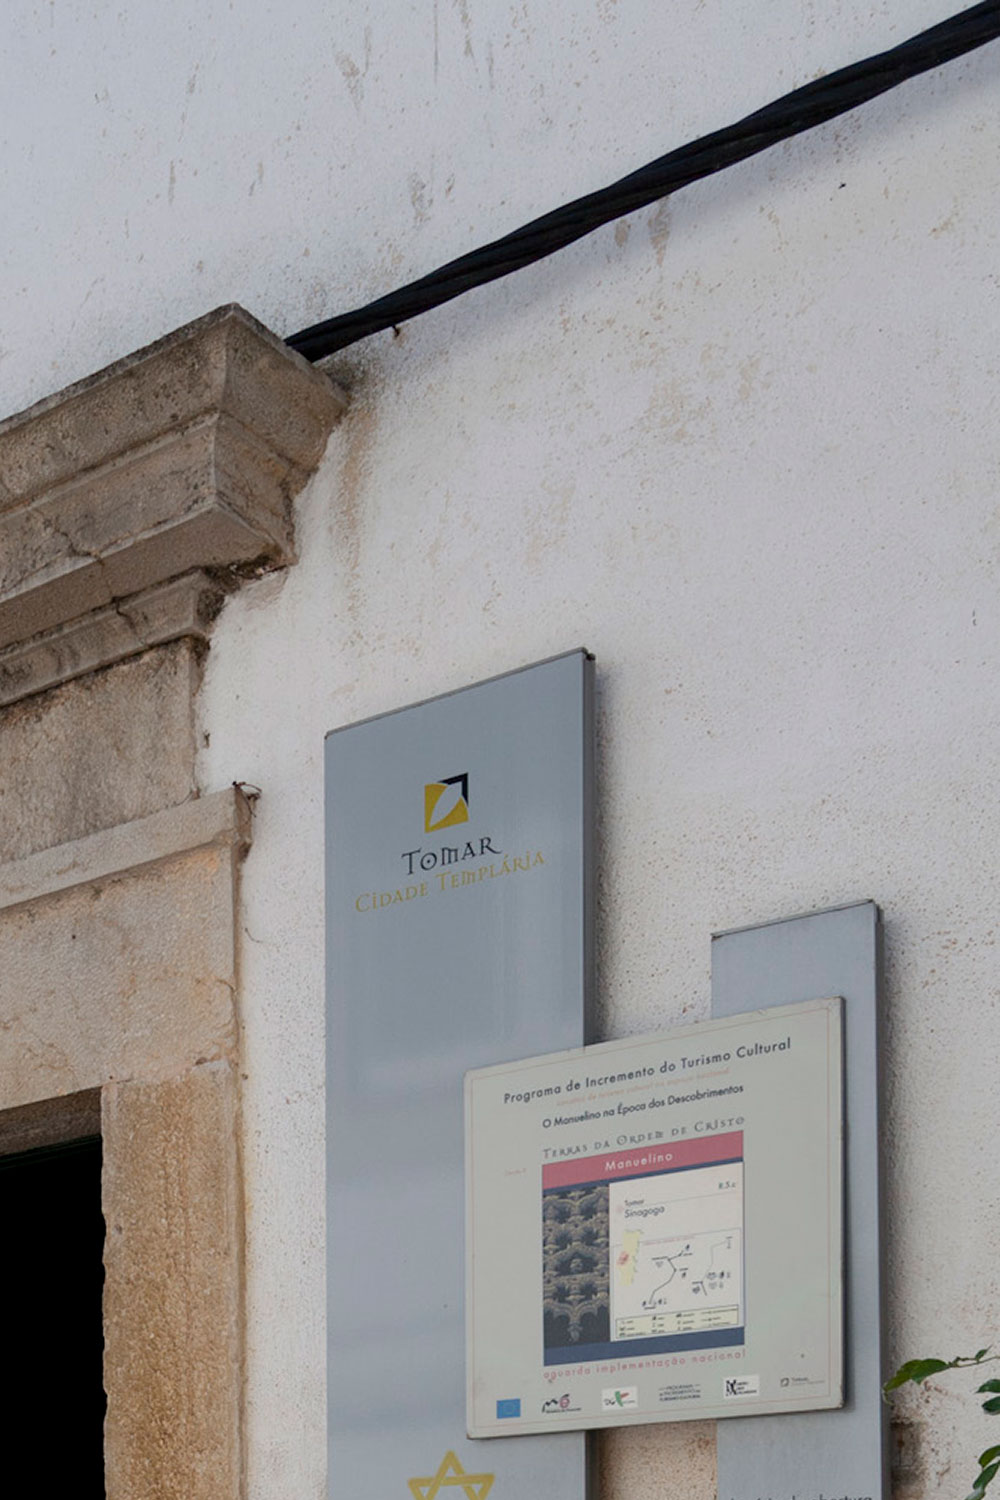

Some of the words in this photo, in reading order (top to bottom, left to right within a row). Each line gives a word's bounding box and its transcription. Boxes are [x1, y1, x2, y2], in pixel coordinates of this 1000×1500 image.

[401, 836, 502, 875] TOMAR
[355, 881, 428, 913] CIDADE
[504, 1085, 561, 1103] Programa
[566, 1079, 580, 1092] de
[585, 1067, 655, 1088] Incremento
[660, 1061, 676, 1074] do
[681, 1052, 731, 1069] Turismo
[736, 1037, 791, 1058] Cultural
[542, 1118, 551, 1128] O
[553, 1110, 601, 1126] Manuelino
[603, 1108, 615, 1118] na
[616, 1098, 646, 1116] Época
[648, 1098, 666, 1109] dos
[667, 1085, 744, 1105] Descobrimentos
[605, 1153, 673, 1171] Manuelino
[624, 1206, 665, 1218] Sinagoga
[543, 1365, 591, 1380] aguarda
[596, 1355, 686, 1374] implementação
[692, 1349, 746, 1363] nacional
